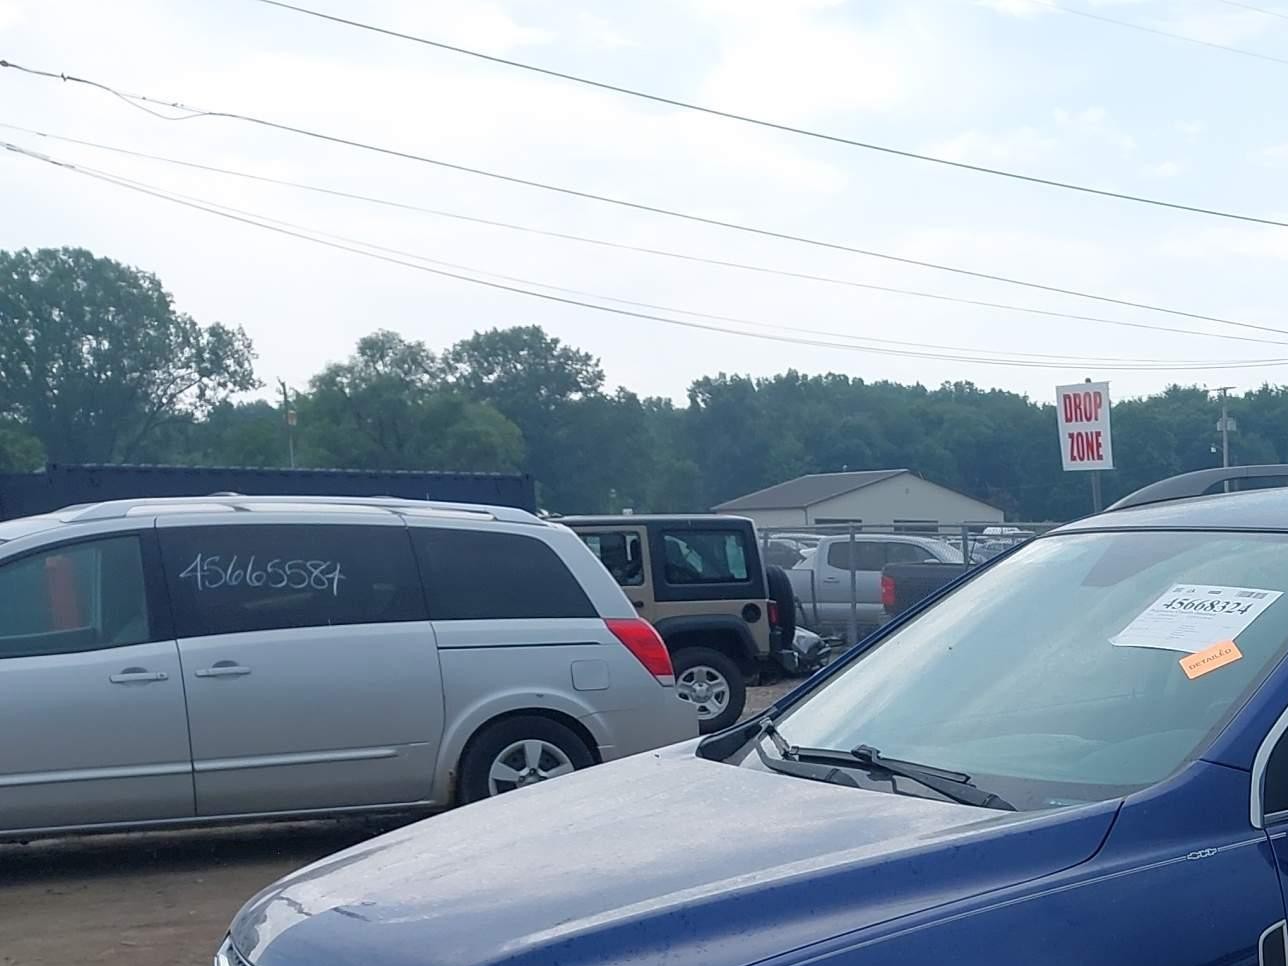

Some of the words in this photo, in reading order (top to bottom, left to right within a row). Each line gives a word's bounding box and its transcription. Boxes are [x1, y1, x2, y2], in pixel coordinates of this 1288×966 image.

[1063, 392, 1102, 423] DROP
[1068, 431, 1104, 461] ZONE
[179, 553, 347, 596] 45665584
[1163, 598, 1253, 615] 45668324
